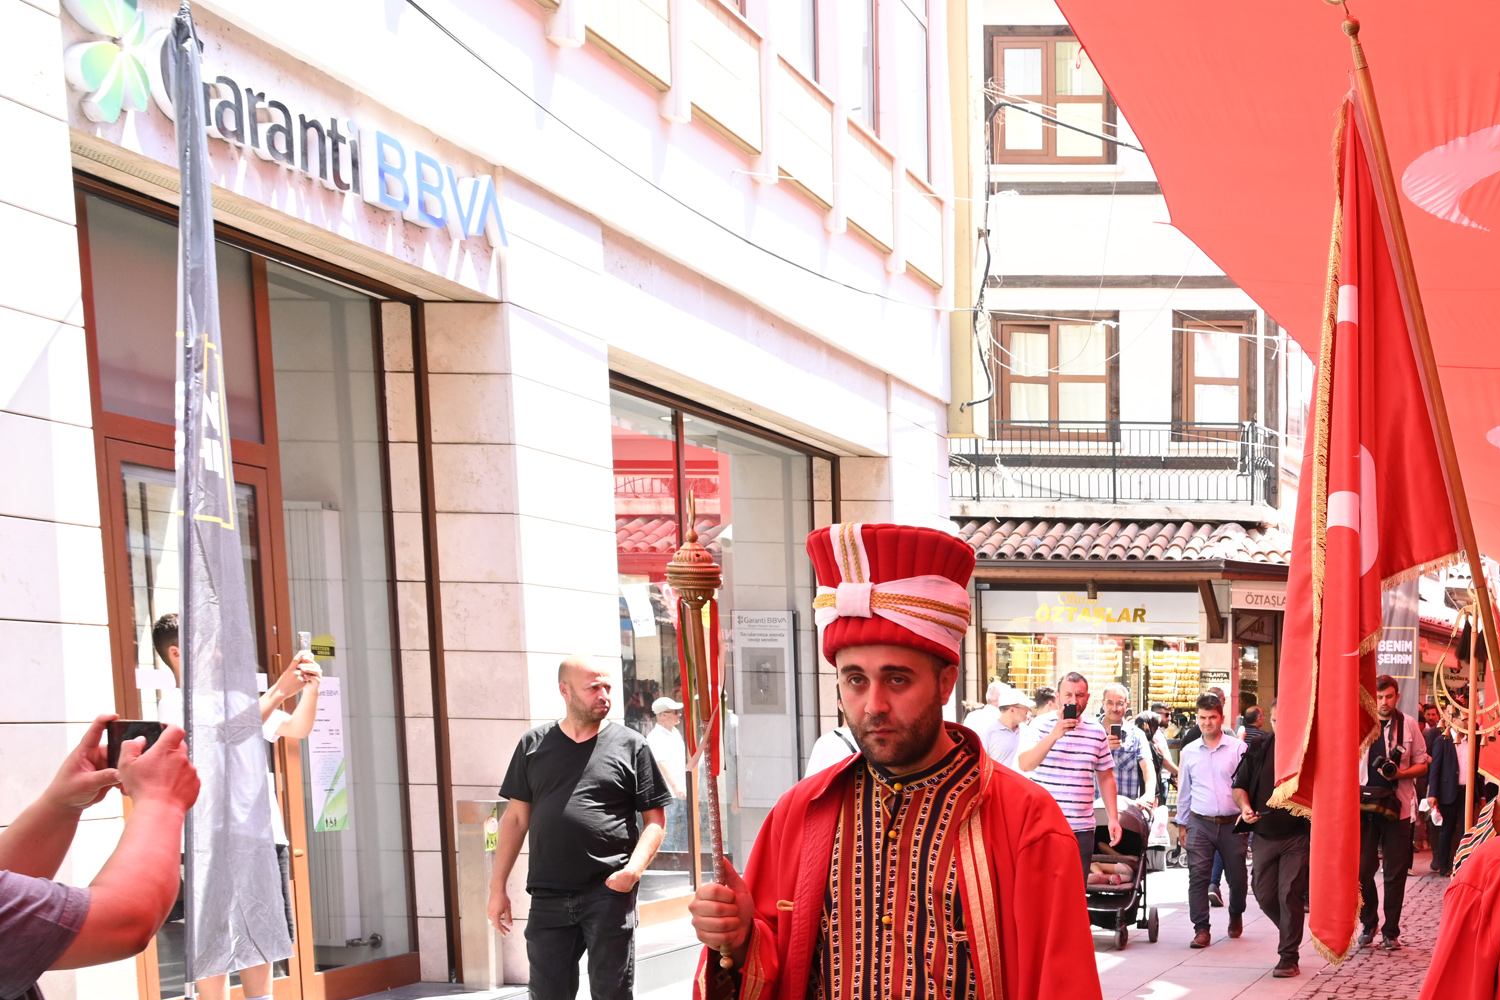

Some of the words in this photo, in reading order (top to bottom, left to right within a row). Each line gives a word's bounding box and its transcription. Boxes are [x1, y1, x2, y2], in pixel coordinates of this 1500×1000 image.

[375, 129, 509, 248] BBVA
[1245, 592, 1287, 608] ÖZTAŞLA
[1036, 603, 1147, 627] ÖZTAŞLAR
